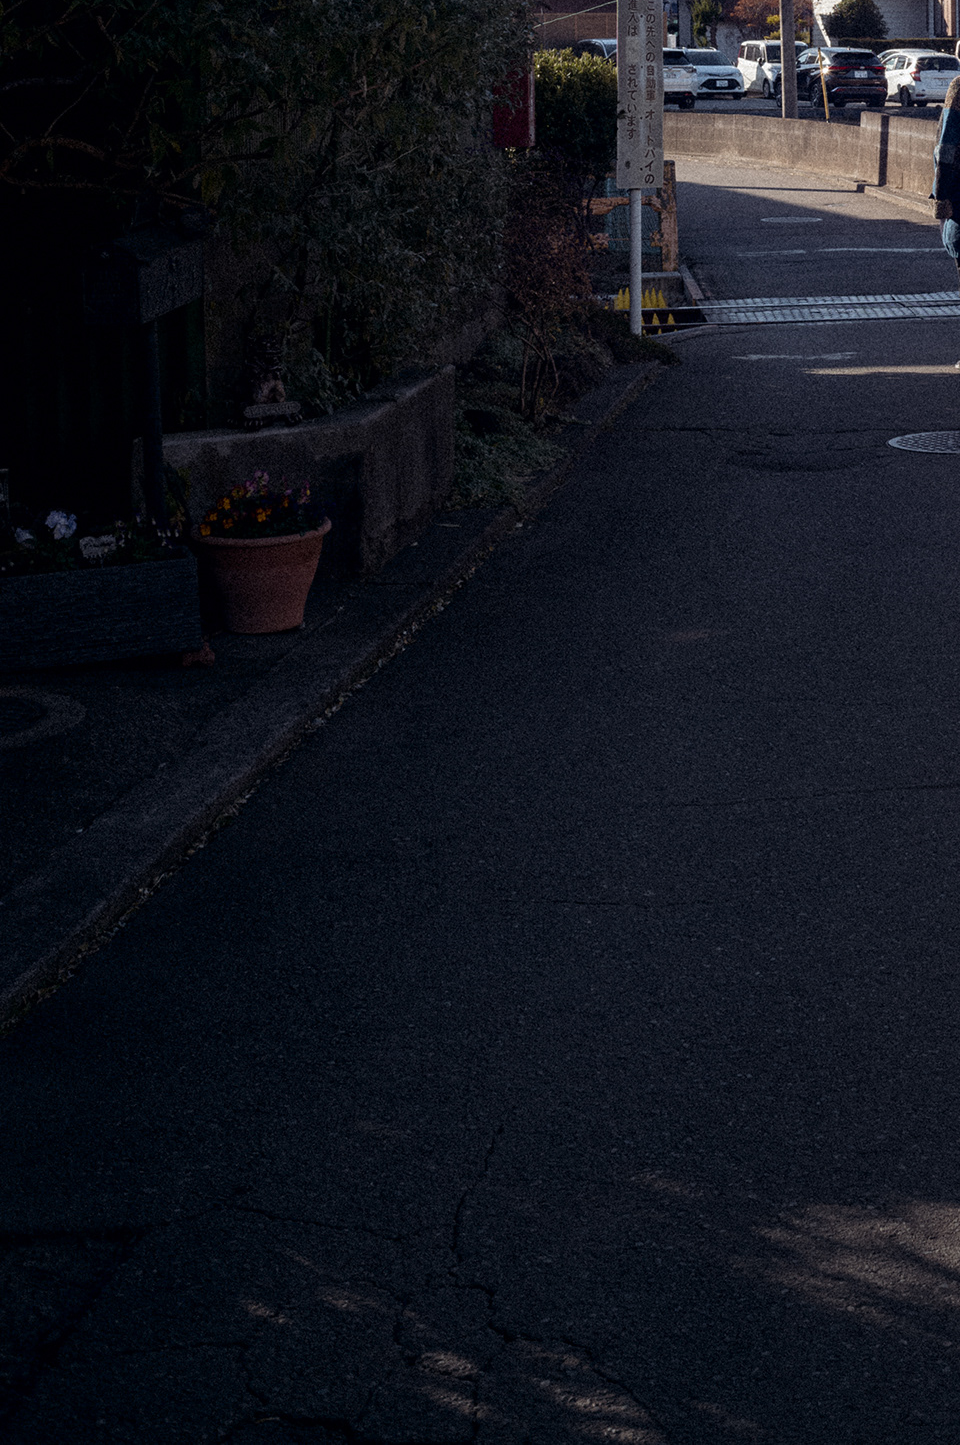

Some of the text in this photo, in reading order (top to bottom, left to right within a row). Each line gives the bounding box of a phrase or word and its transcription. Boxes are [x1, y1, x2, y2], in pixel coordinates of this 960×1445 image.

[626, 63, 639, 140] されています
